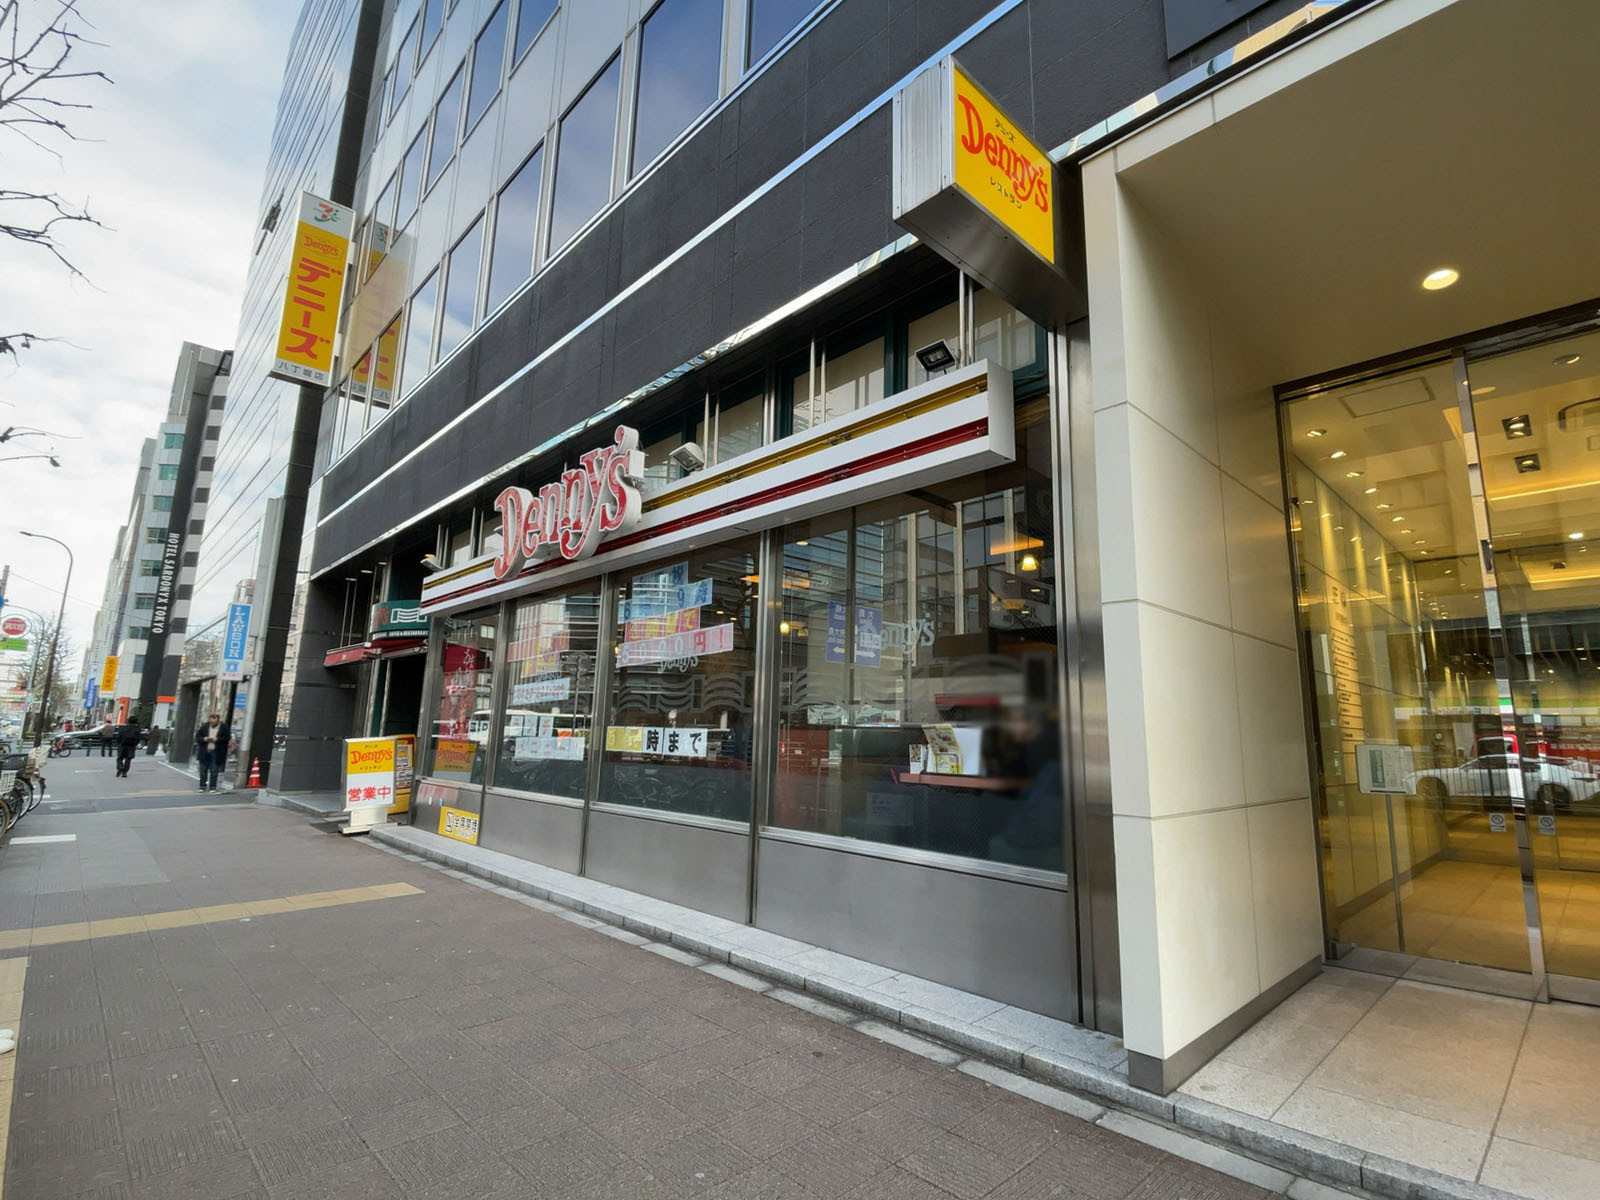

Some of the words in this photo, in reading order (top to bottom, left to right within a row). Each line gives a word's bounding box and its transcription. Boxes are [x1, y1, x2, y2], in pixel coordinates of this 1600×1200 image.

[958, 93, 1049, 214] Denny's
[990, 176, 1022, 209] レストラン
[285, 257, 342, 360] デニーズ
[494, 424, 640, 580] Denny's
[165, 532, 180, 558] HOTEL
[157, 559, 175, 604] SARDONYX
[152, 605, 168, 634] TOKYO
[229, 606, 245, 658] LAWSON
[350, 747, 393, 765] Denny's
[347, 785, 392, 803] 営業中
